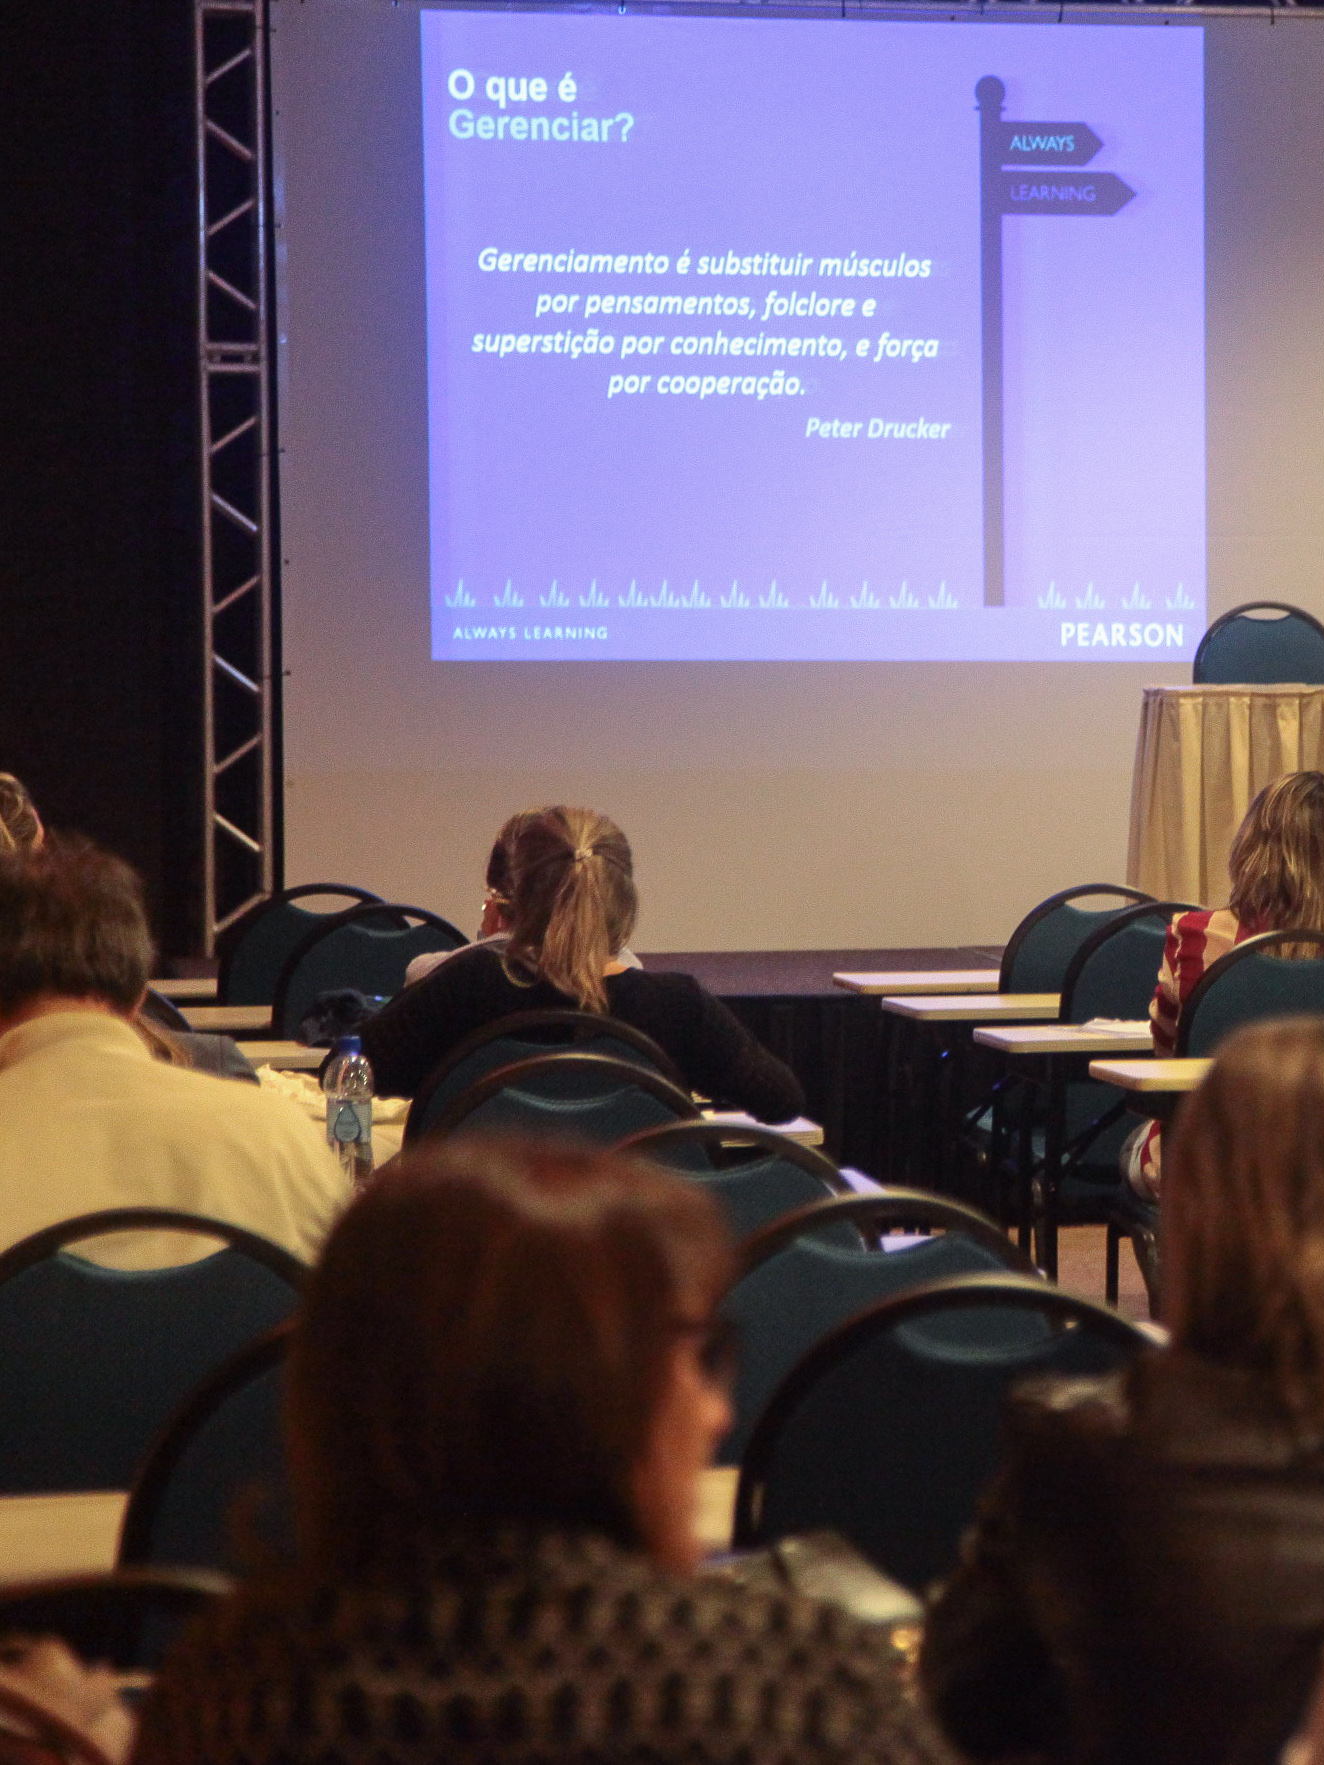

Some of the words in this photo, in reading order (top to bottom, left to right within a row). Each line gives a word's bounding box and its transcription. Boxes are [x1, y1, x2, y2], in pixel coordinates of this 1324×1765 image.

[448, 69, 475, 99] O
[486, 76, 547, 107] que
[558, 71, 577, 101] é
[448, 109, 634, 142] Gerenciar?
[1010, 135, 1075, 151] ALWAYS
[1010, 185, 1097, 202] LEARNING
[478, 247, 669, 274] Gerenciamento
[676, 248, 691, 274] é
[697, 250, 813, 276] substituir
[819, 251, 932, 278] músculos
[535, 294, 579, 318] por
[585, 294, 756, 320] pensamentos,
[761, 290, 856, 321] folclore
[862, 298, 877, 317] e
[471, 328, 615, 359] superstição
[620, 335, 665, 359] por
[670, 330, 847, 361] conhecimento,
[856, 338, 870, 357] e
[873, 332, 939, 363] força
[607, 374, 651, 399] por
[657, 369, 805, 400] cooperação.
[806, 417, 863, 438] Peter
[868, 417, 952, 439] Drucker
[453, 625, 516, 640] ALWAYS
[523, 625, 608, 640] LEARNING
[1060, 622, 1184, 647] PEARSON
